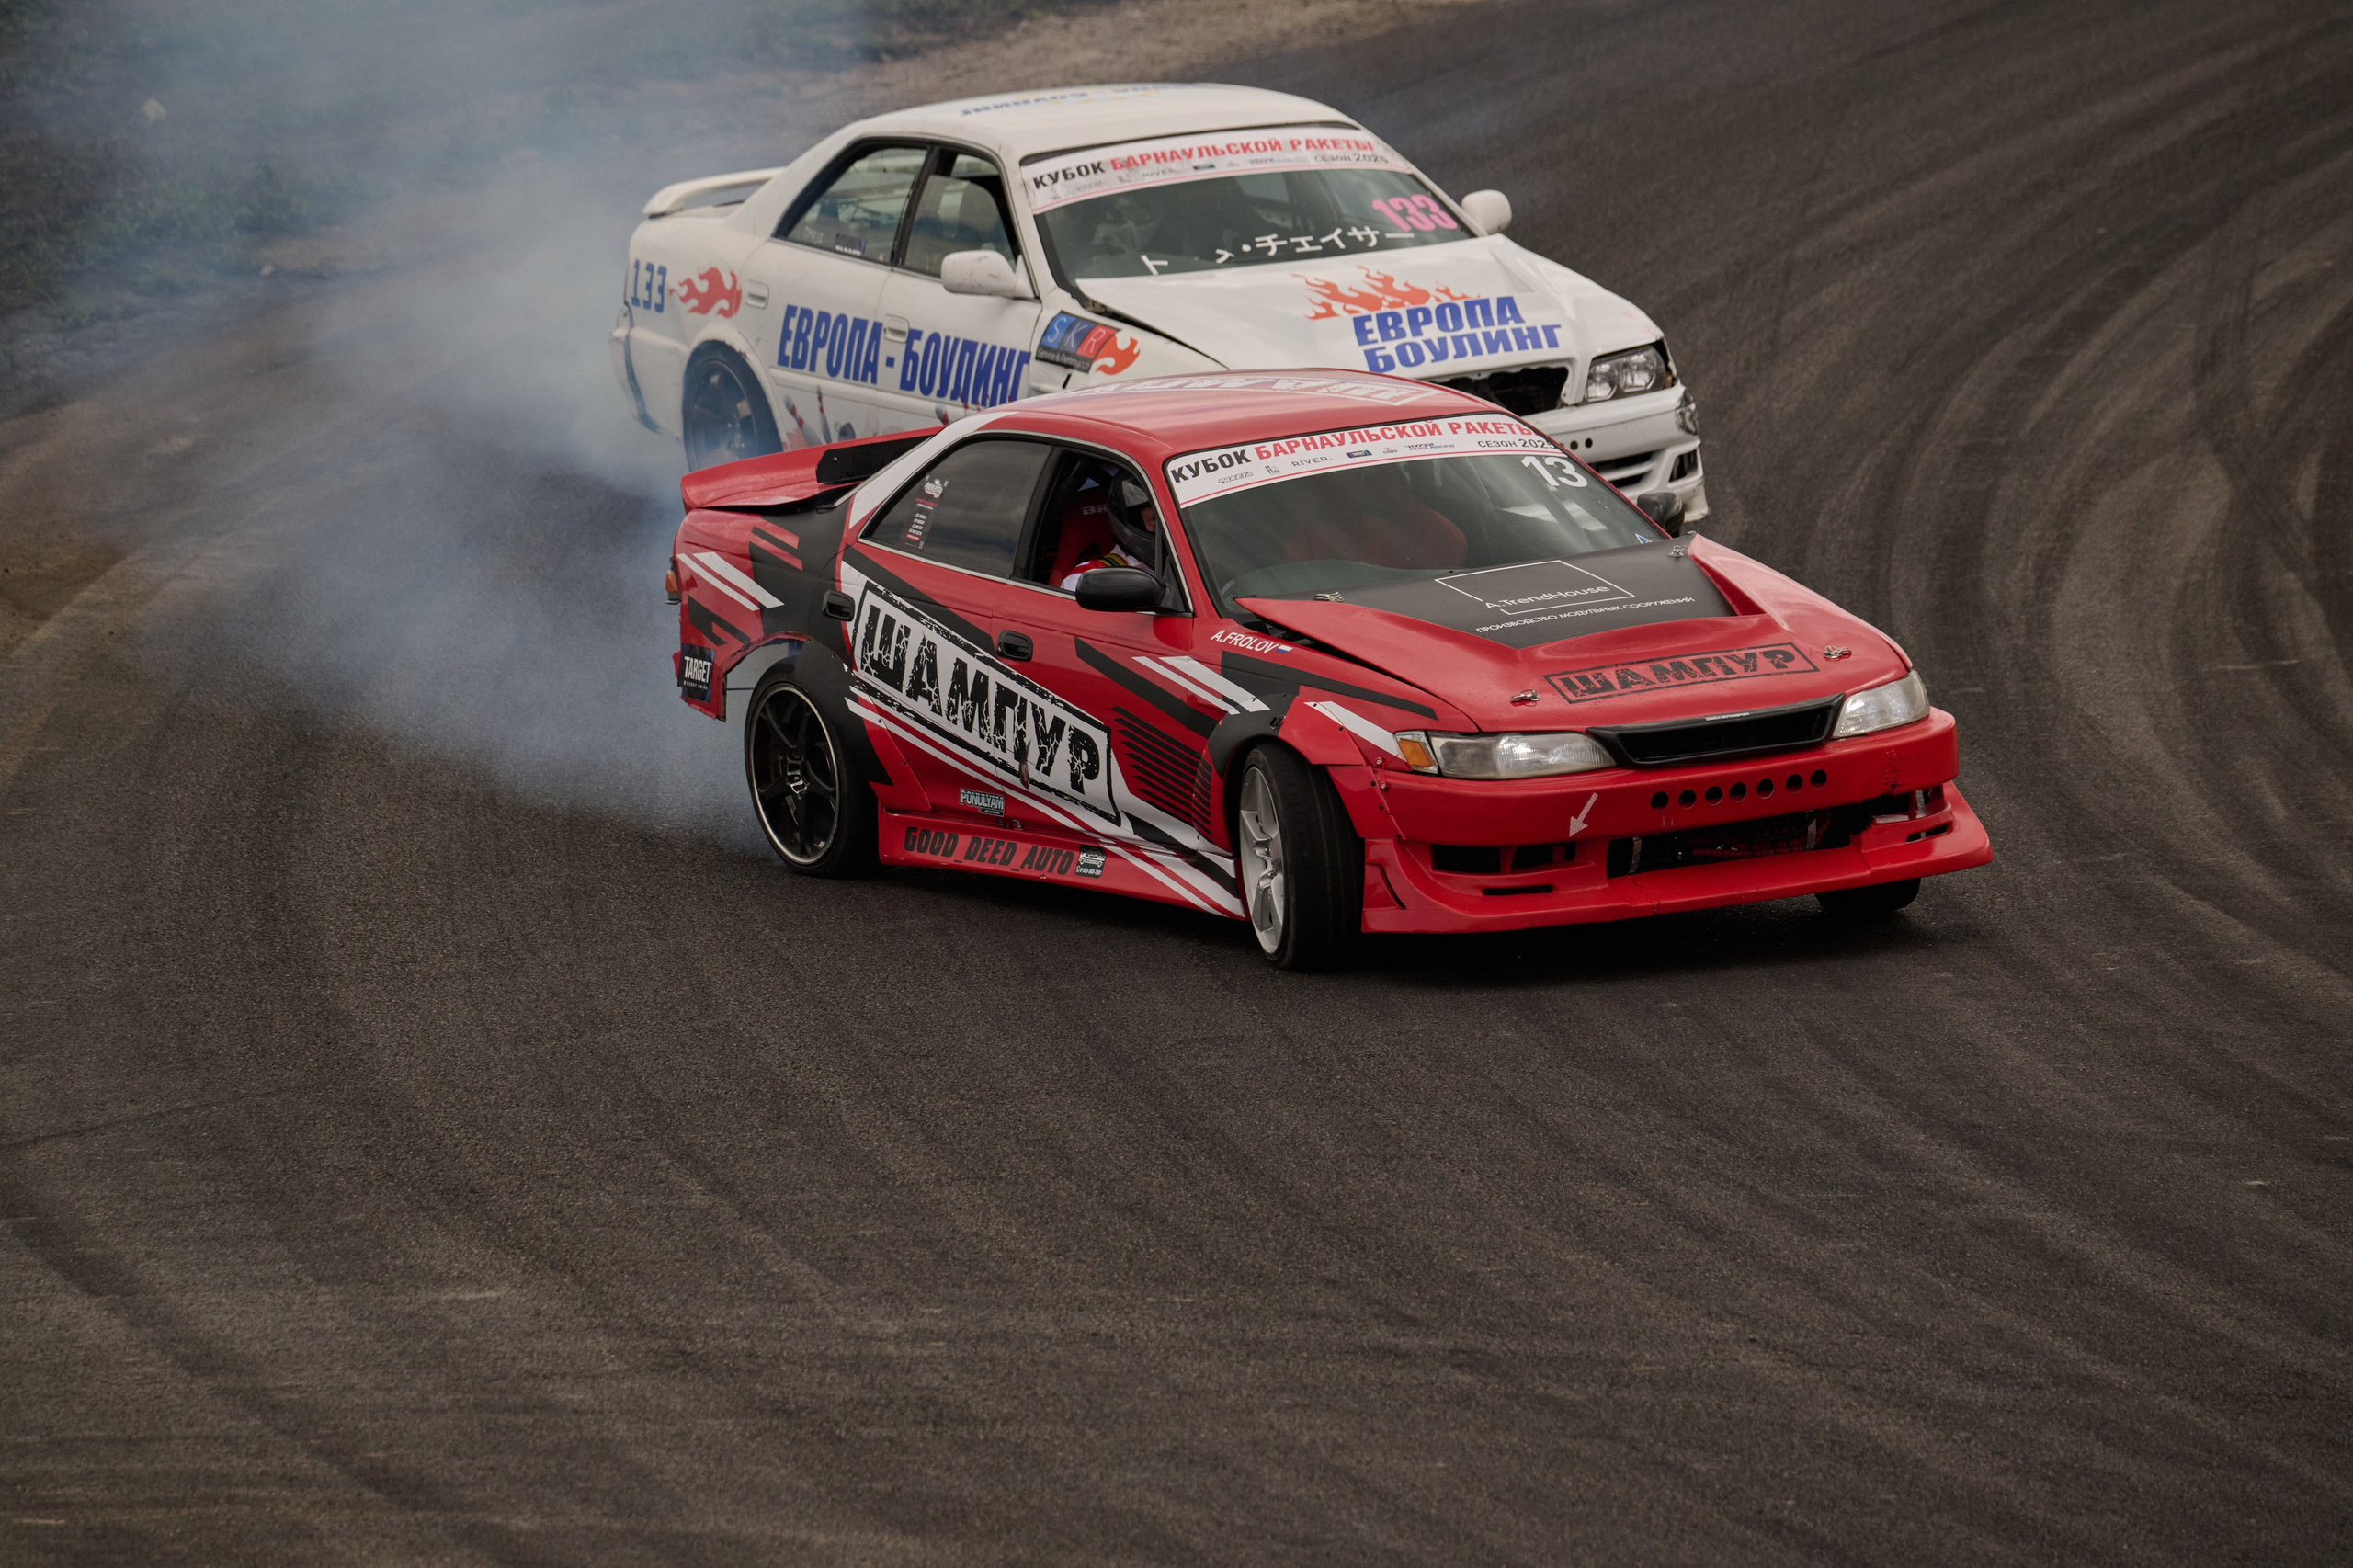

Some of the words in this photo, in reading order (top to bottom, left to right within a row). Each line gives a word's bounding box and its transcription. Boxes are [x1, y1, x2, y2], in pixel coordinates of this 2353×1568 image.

[1033, 160, 1106, 189] КУБОК
[1109, 138, 1283, 172] БАРНАУЛЬСКОЙ
[1290, 137, 1375, 152] РАКЕТЫ
[1371, 194, 1459, 232] 133
[631, 258, 668, 313] 133
[1352, 296, 1527, 346] ЕВРОПА
[778, 304, 883, 386] ЕВРОПА
[899, 328, 1031, 407] БОУЛИНГ
[1363, 324, 1562, 373] БОУЛИНГ
[1170, 449, 1252, 483] КУБОК
[1254, 420, 1443, 460] БАРНАУЛЬСКОЙ
[1477, 439, 1517, 449] СЕЗОН
[1520, 456, 1588, 488] 13
[1475, 615, 1558, 633] ПРОИЗВОДСТВО
[1559, 605, 1623, 619] МОДУЛЬНЫХ
[1623, 597, 1696, 610] СООРУЖЕНИЙ
[1485, 586, 1610, 609] A.TrendHouse
[1211, 629, 1279, 653] A.FROLOV
[684, 656, 712, 683] TARGET
[1559, 648, 1796, 698] ШАМПУР
[859, 603, 1101, 796] ШАМПУР
